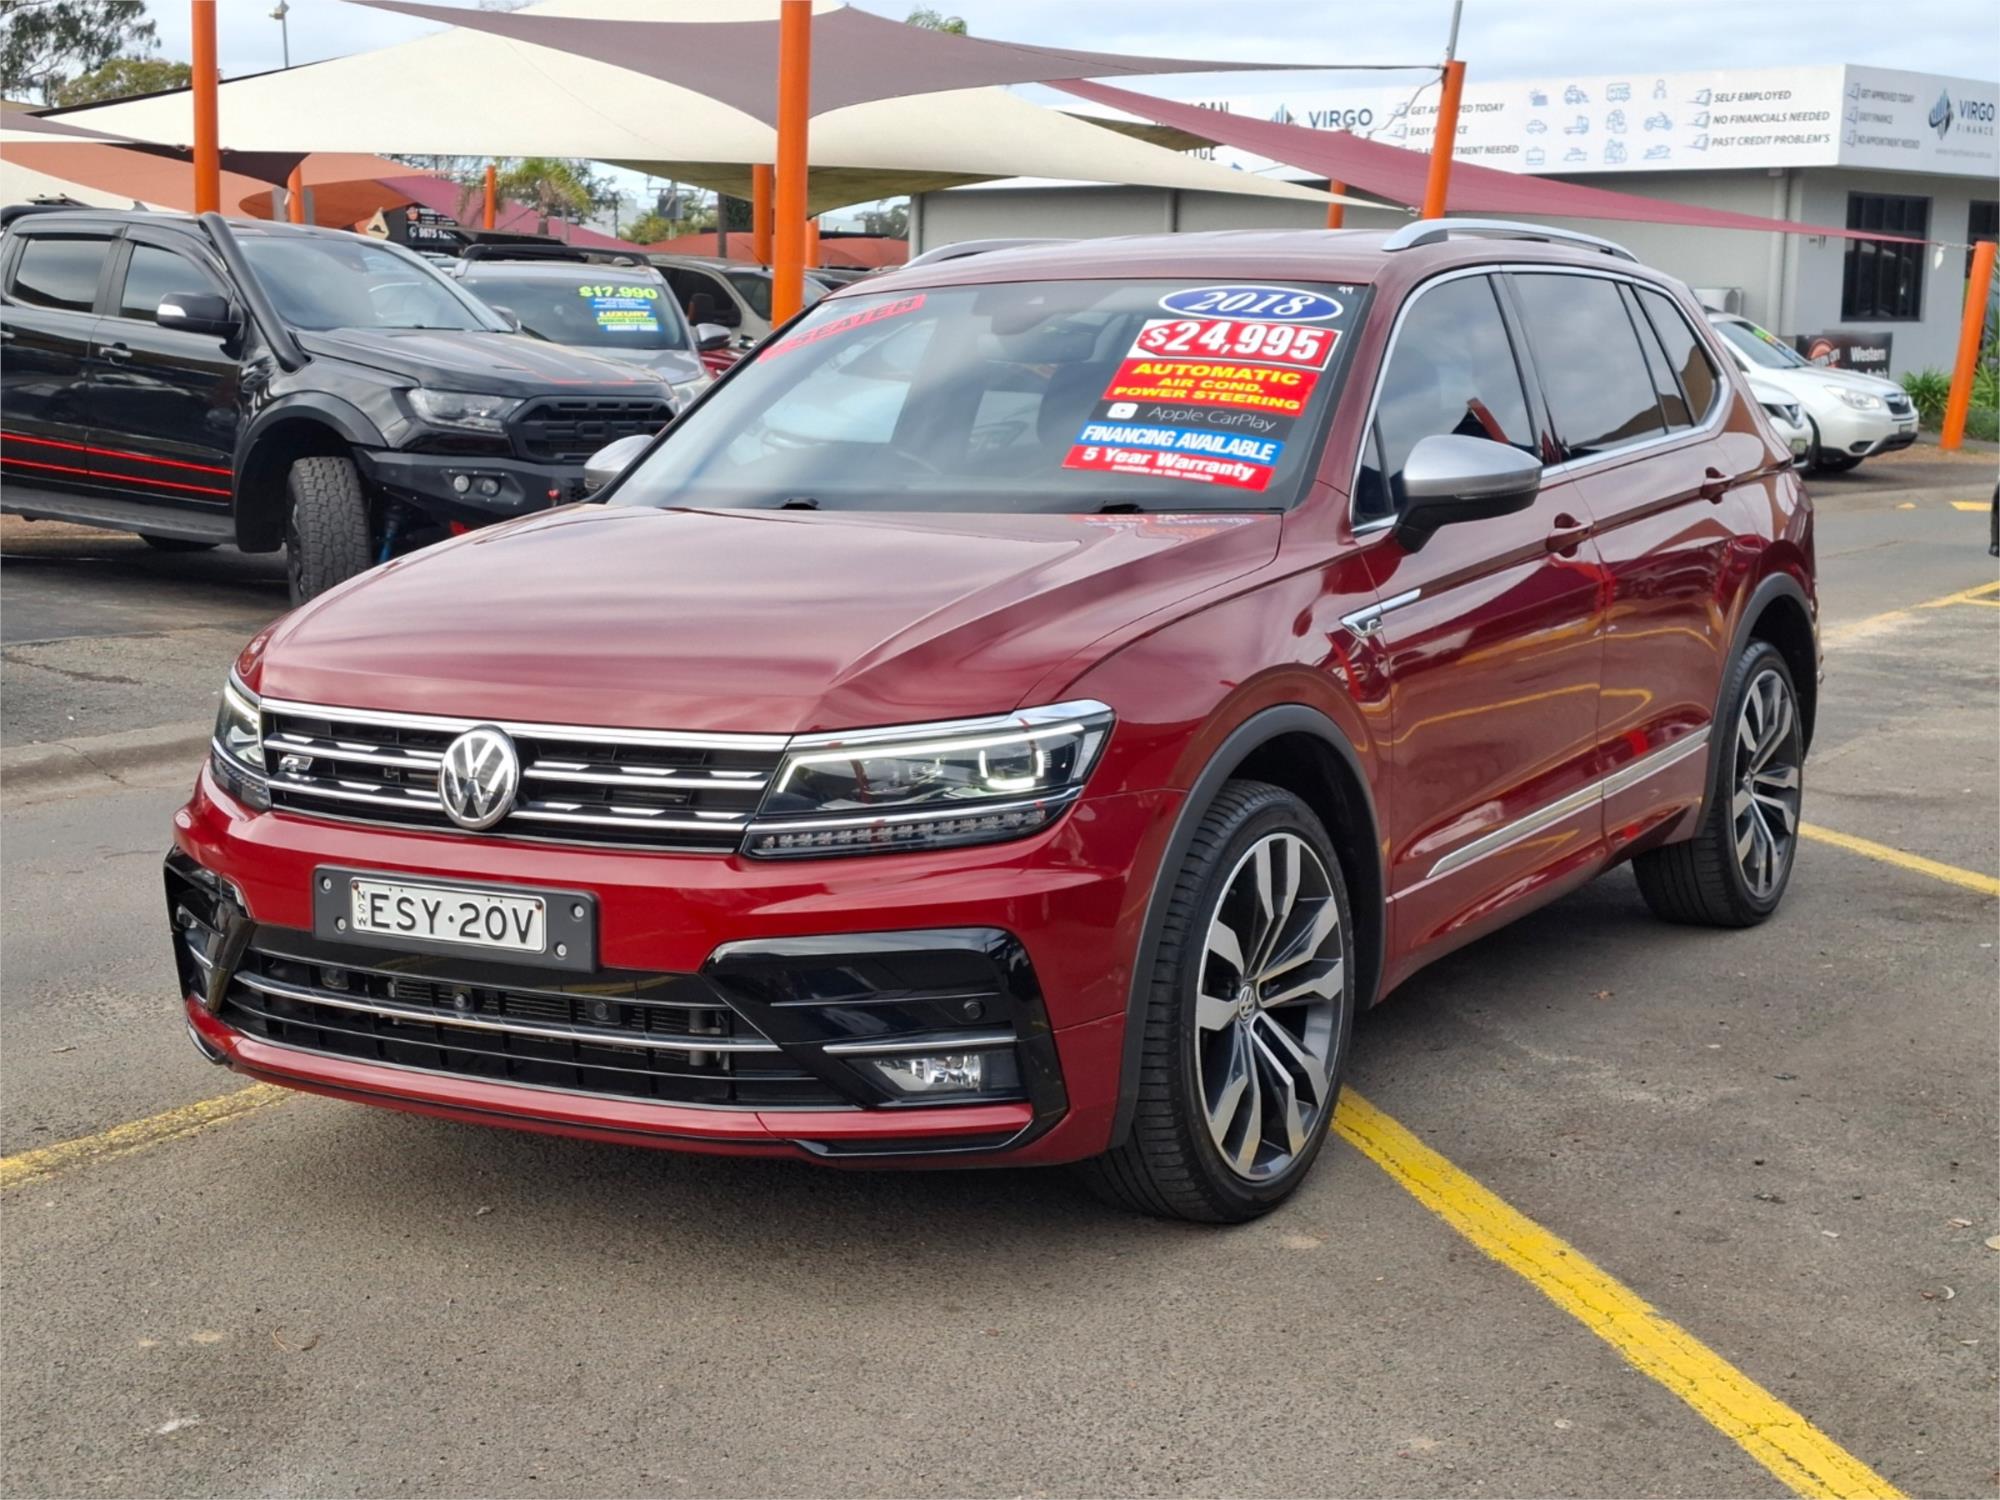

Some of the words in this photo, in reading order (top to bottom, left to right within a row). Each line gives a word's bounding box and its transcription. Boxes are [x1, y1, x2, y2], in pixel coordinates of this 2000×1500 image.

[1714, 92, 1736, 103] SELF
[1738, 90, 1792, 102] EMPLOYED
[1308, 108, 1373, 128] VIRGO
[1411, 106, 1427, 115] GET
[1475, 103, 1504, 113] TODAY
[1713, 115, 1728, 124] NO
[1729, 113, 1787, 123] FINANCIALS
[1789, 111, 1830, 122] NEEDED
[1959, 100, 1995, 121] VIRGO
[1410, 127, 1431, 136] EASY
[1712, 137, 1736, 147] PAST
[1737, 135, 1772, 146] CREDIT
[1773, 134, 1831, 145] PROBLEM'S
[1485, 145, 1519, 154] NEEDED
[1184, 291, 1316, 315] 2018
[1145, 321, 1324, 360] $24,995
[1850, 347, 1886, 361] Western
[1132, 363, 1302, 386] AUTOMATIC
[1157, 378, 1195, 388] AIR
[1200, 380, 1264, 393] COND.
[1113, 387, 1188, 398] POWER
[1193, 391, 1301, 410] STEERING
[1147, 406, 1204, 422] Apple
[1207, 411, 1277, 432] CarPlay
[1081, 425, 1177, 448] FINANCING
[1175, 432, 1277, 461] AVAILABLE
[1082, 447, 1098, 460] 5
[1103, 448, 1153, 465] Year
[1156, 452, 1256, 481] Warranty
